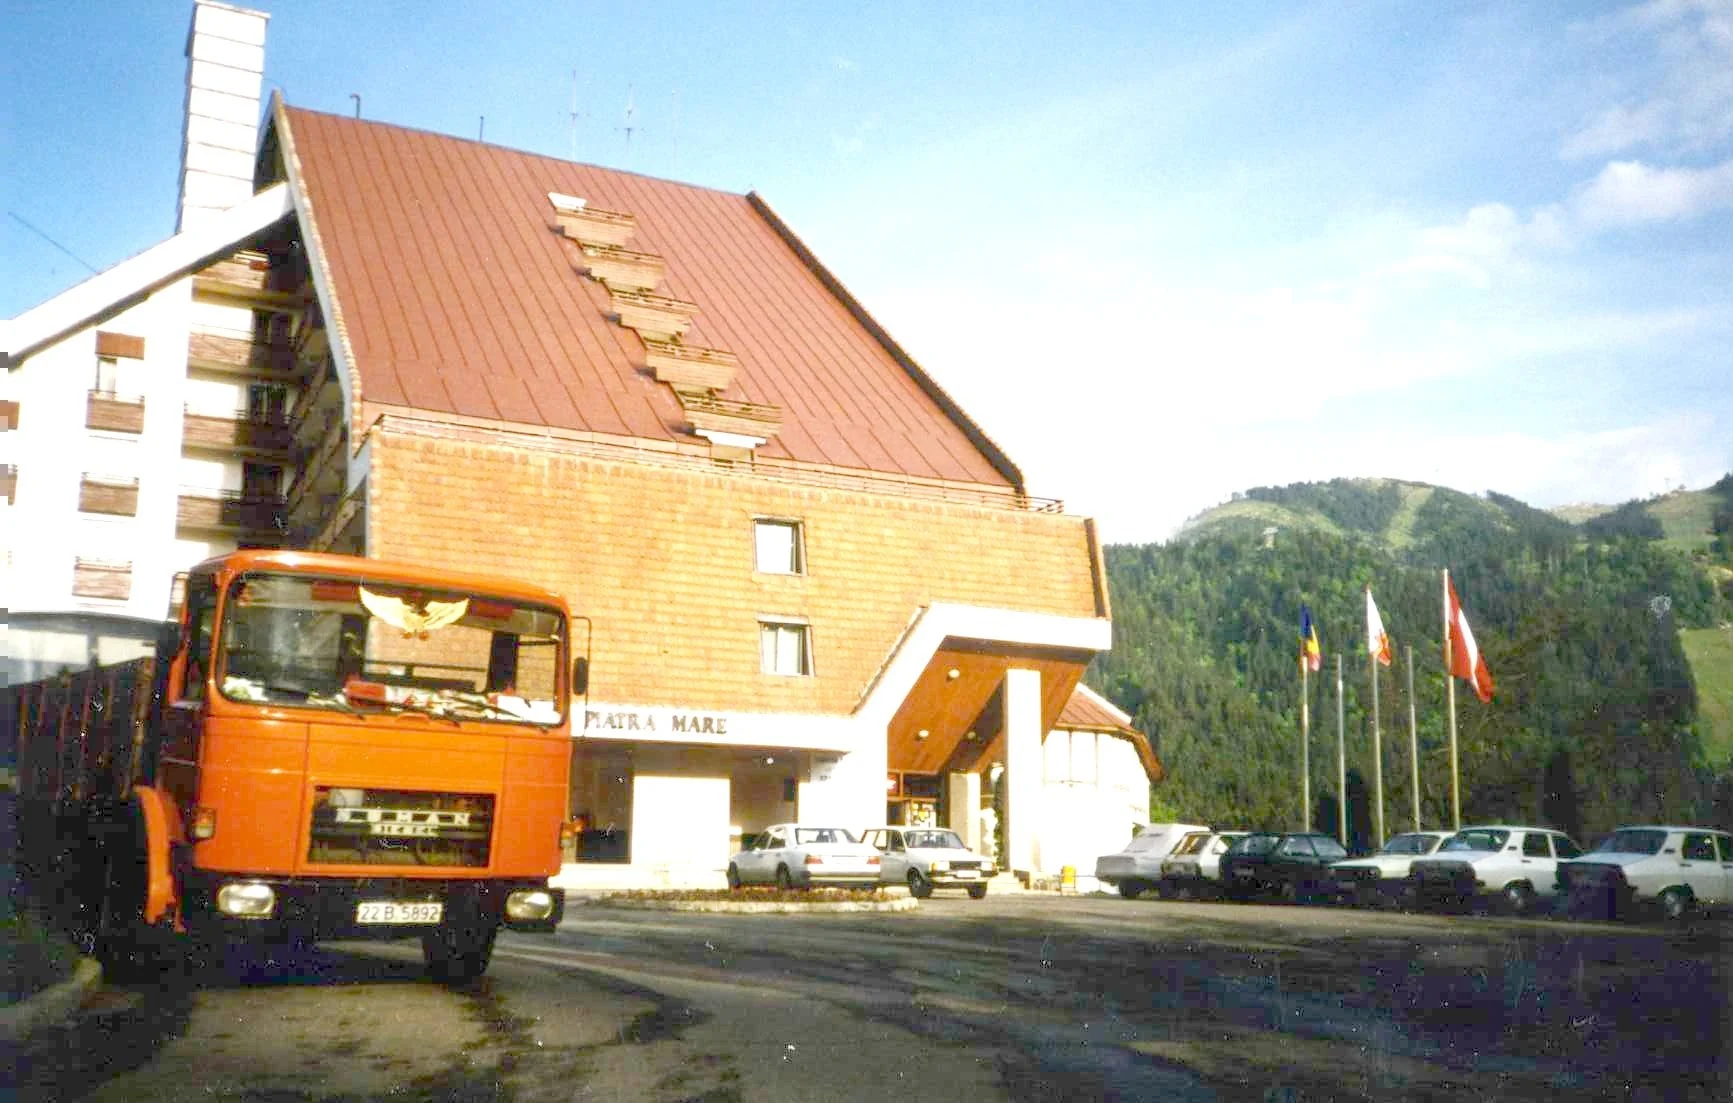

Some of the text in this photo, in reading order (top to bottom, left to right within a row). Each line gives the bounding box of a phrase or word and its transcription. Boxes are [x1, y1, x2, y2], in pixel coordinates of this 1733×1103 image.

[585, 709, 728, 735] PIATRA MARE
[361, 906, 439, 920] 22 B 5892
